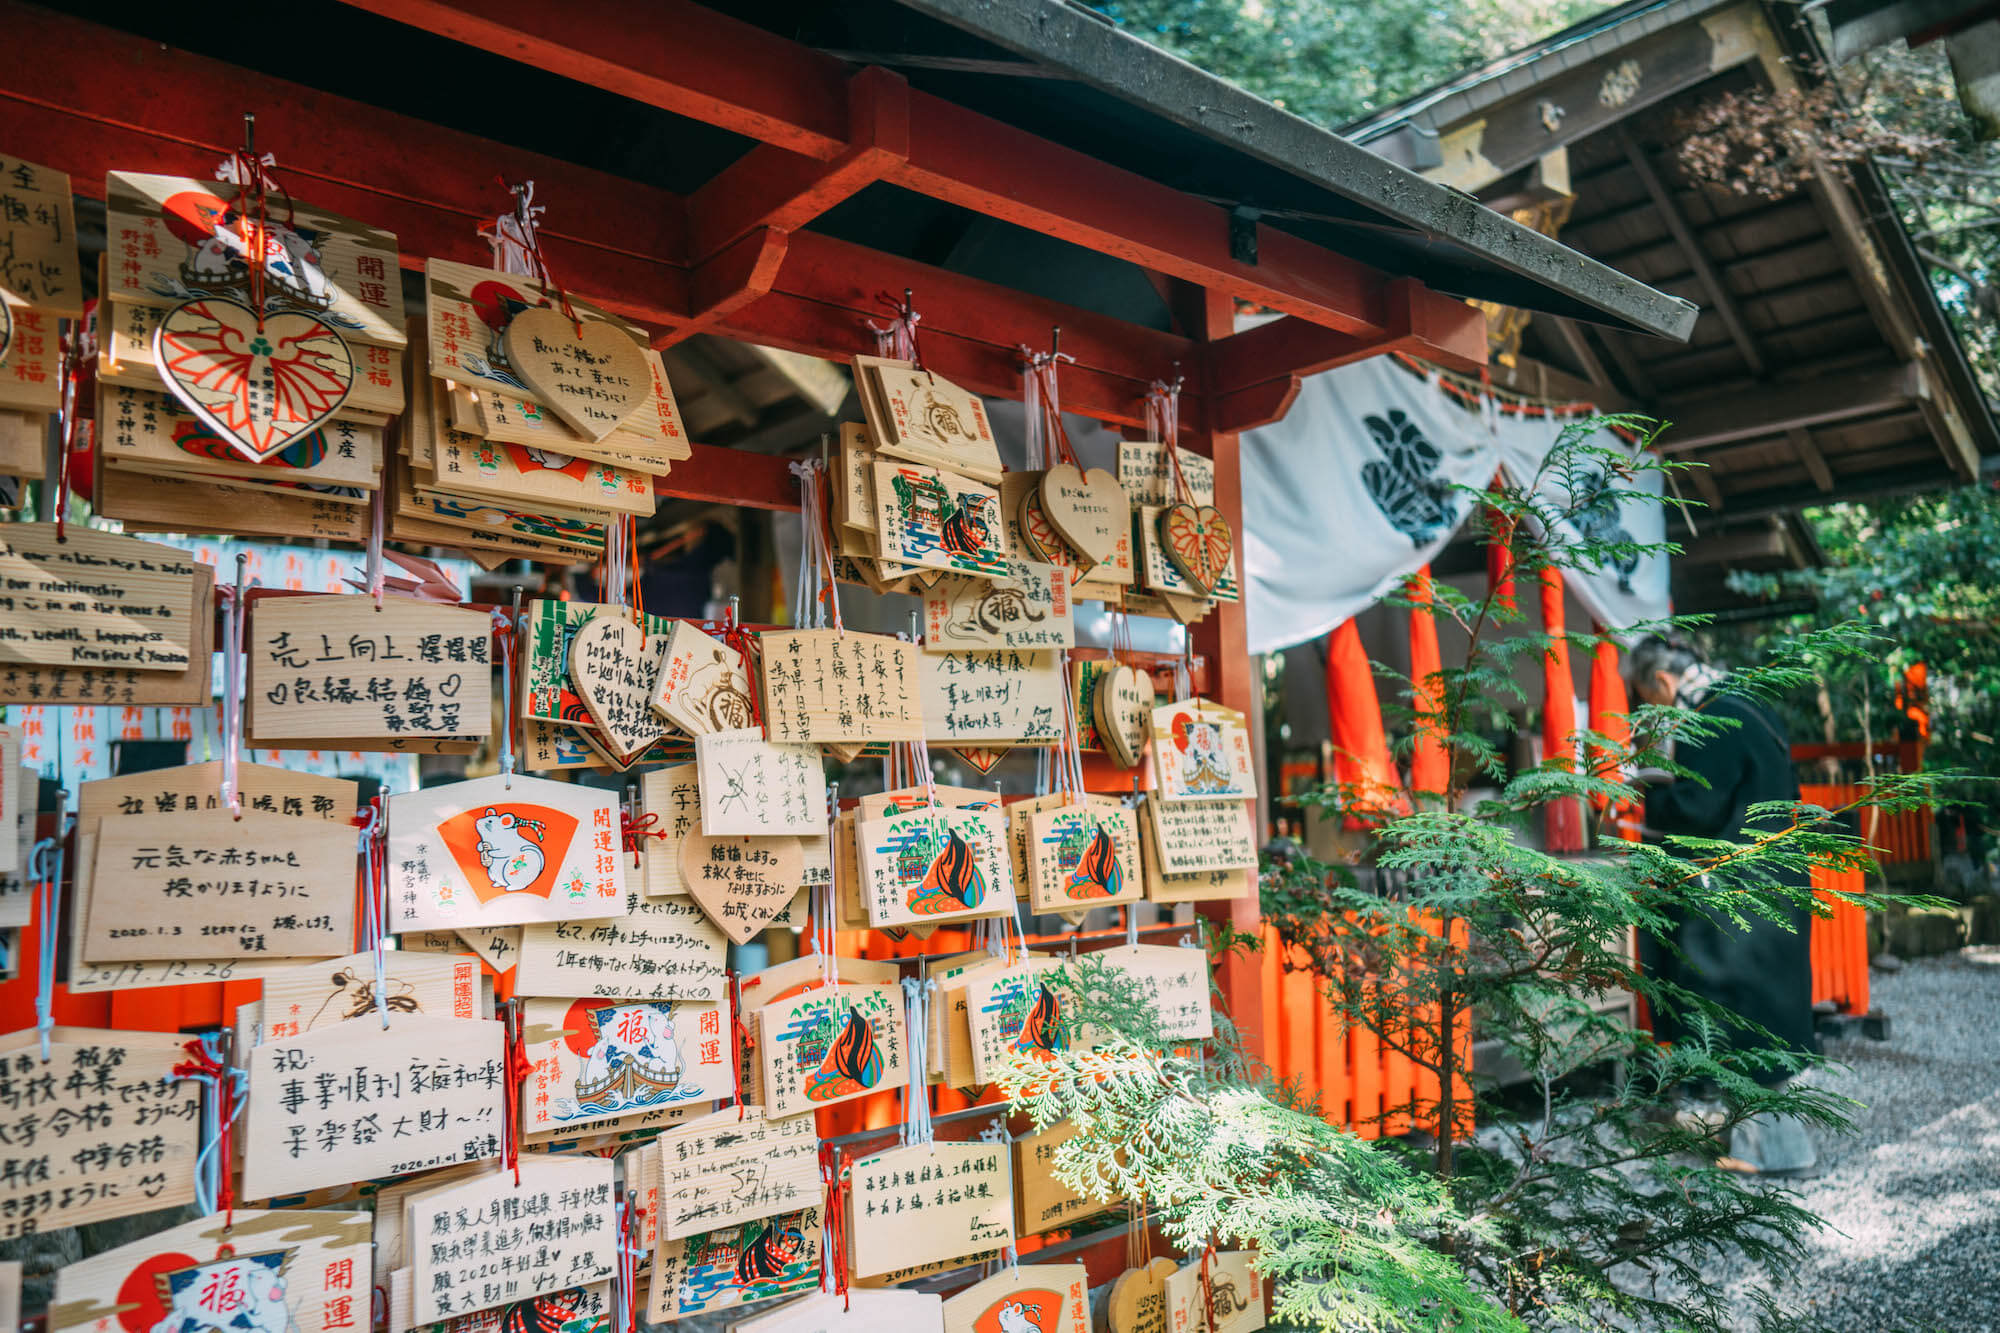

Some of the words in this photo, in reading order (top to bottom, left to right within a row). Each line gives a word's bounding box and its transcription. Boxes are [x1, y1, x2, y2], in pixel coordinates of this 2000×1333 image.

[120, 229, 145, 290] 野宮神社
[356, 254, 391, 308] 開運
[440, 311, 461, 368] 野宮神社
[336, 420, 359, 459] 安産
[988, 596, 1021, 624] 福
[535, 656, 549, 714] 野宮神社
[719, 695, 744, 729] 福
[132, 845, 300, 869] 元気な赤ちゃんを
[593, 807, 617, 899] 開運招福
[163, 878, 310, 899] 授かりますように
[401, 859, 419, 920] 野宮神社
[727, 882, 786, 897] なりますように
[875, 868, 890, 920] 野宮神社
[617, 1010, 650, 1046] 福
[699, 1010, 723, 1065] 開運
[886, 1003, 900, 1070] 子宝安産
[534, 1059, 551, 1124] 野宮神社
[774, 1056, 788, 1111] 野宮神社
[201, 1267, 249, 1315] 福
[322, 1258, 356, 1332] 開運
[661, 1256, 678, 1313] 野宮神社
